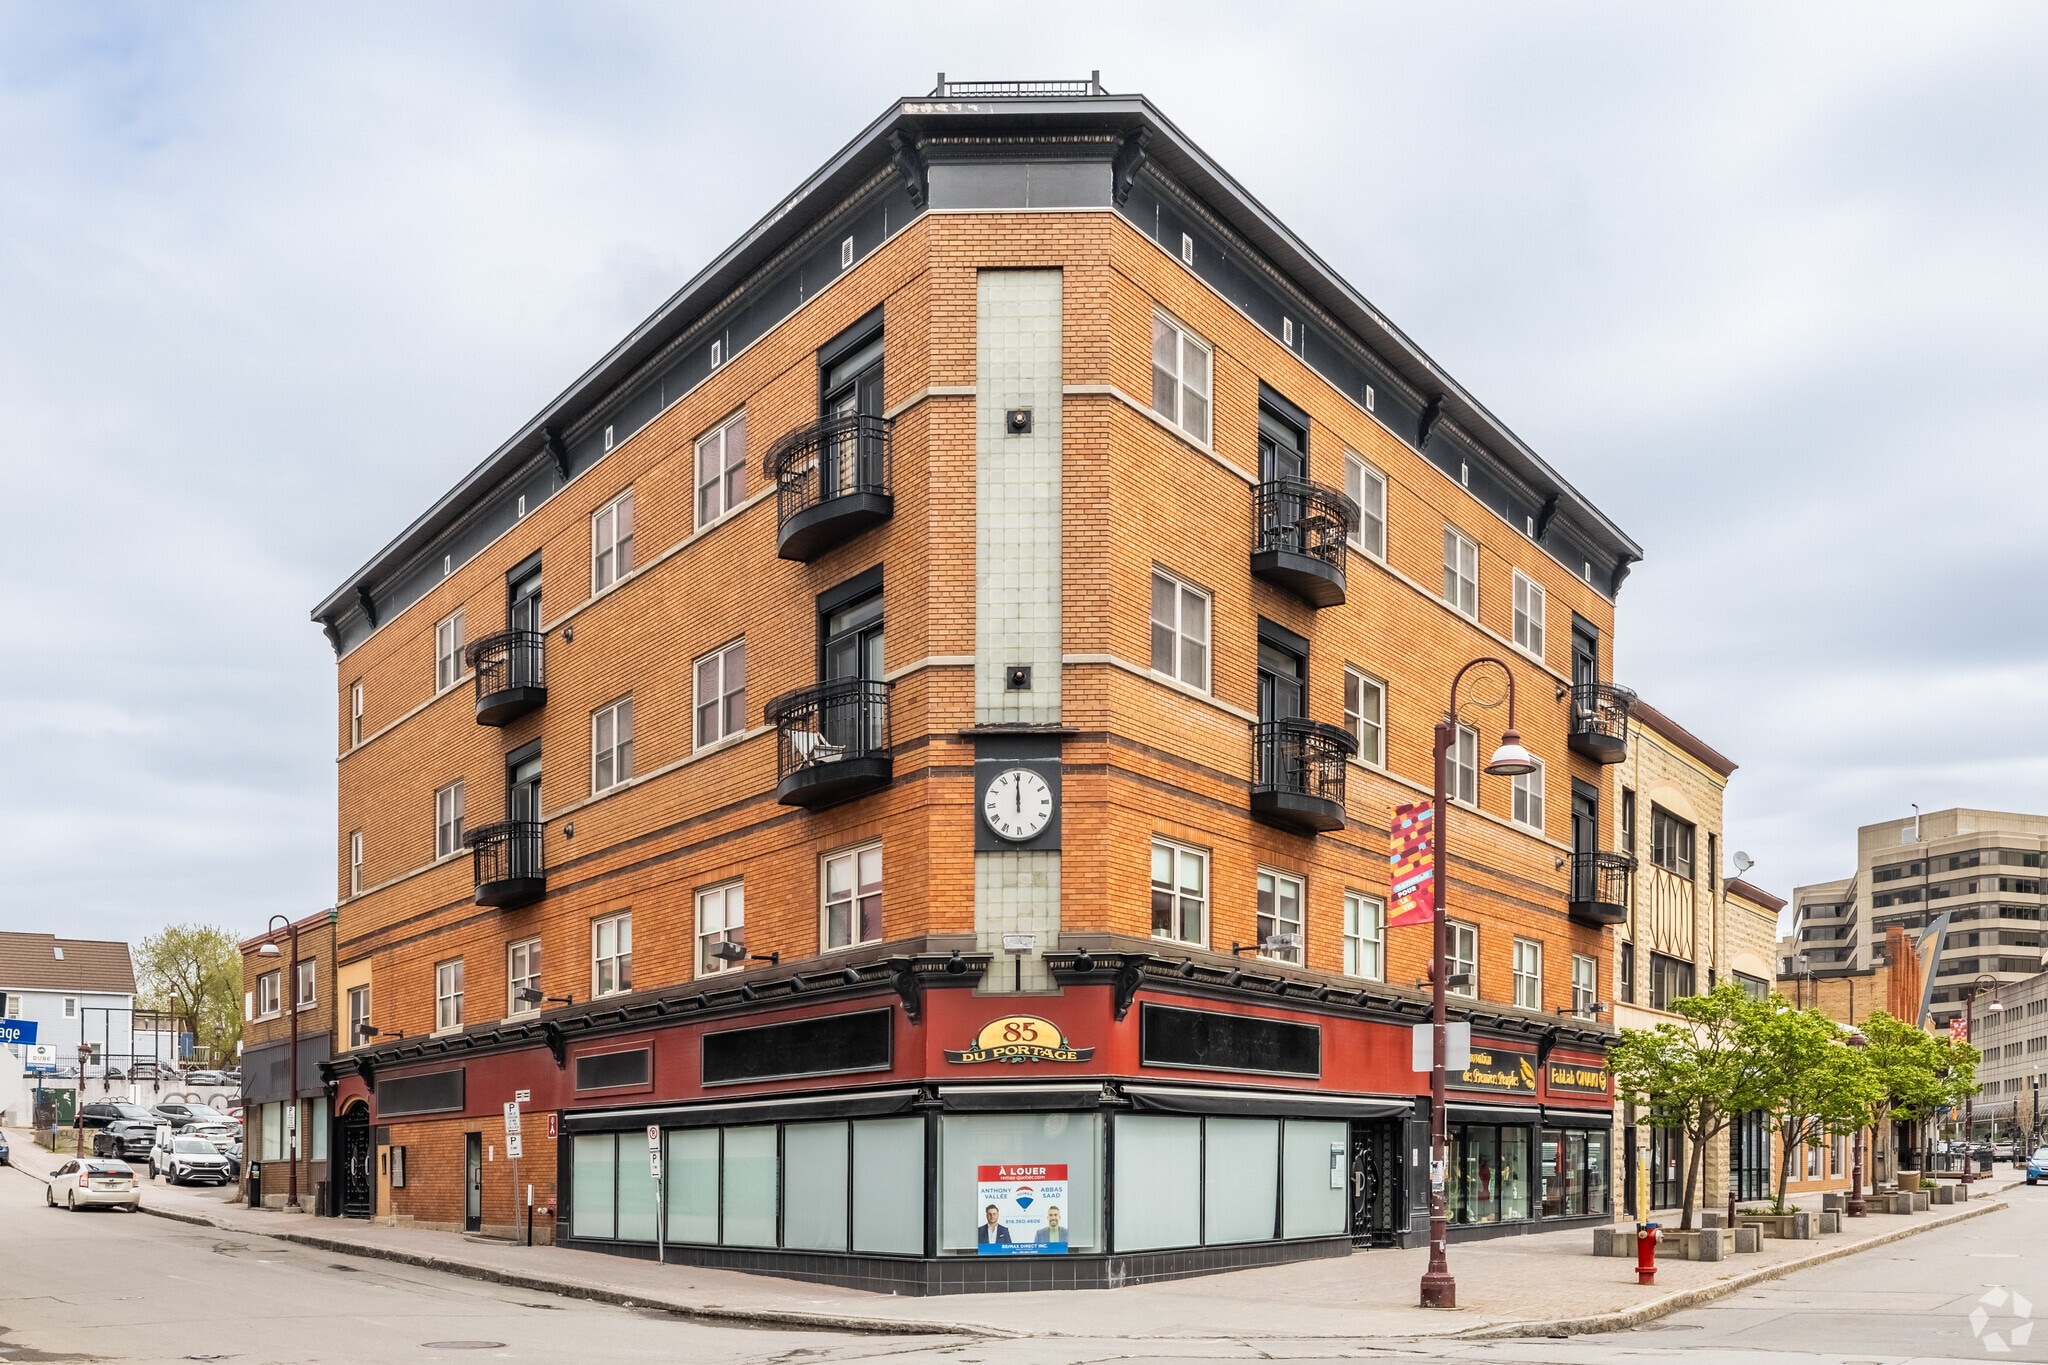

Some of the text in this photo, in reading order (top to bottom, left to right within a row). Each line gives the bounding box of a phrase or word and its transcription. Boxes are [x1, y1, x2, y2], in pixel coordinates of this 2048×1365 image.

[1398, 886, 1417, 898] POUR
[1002, 1022, 1038, 1042] 85
[962, 1045, 1077, 1062] DU PORTAGE
[1462, 1068, 1519, 1090] des Premiers Peuples
[1551, 1067, 1575, 1085] FabLab
[999, 1165, 1046, 1175] À LOUER
